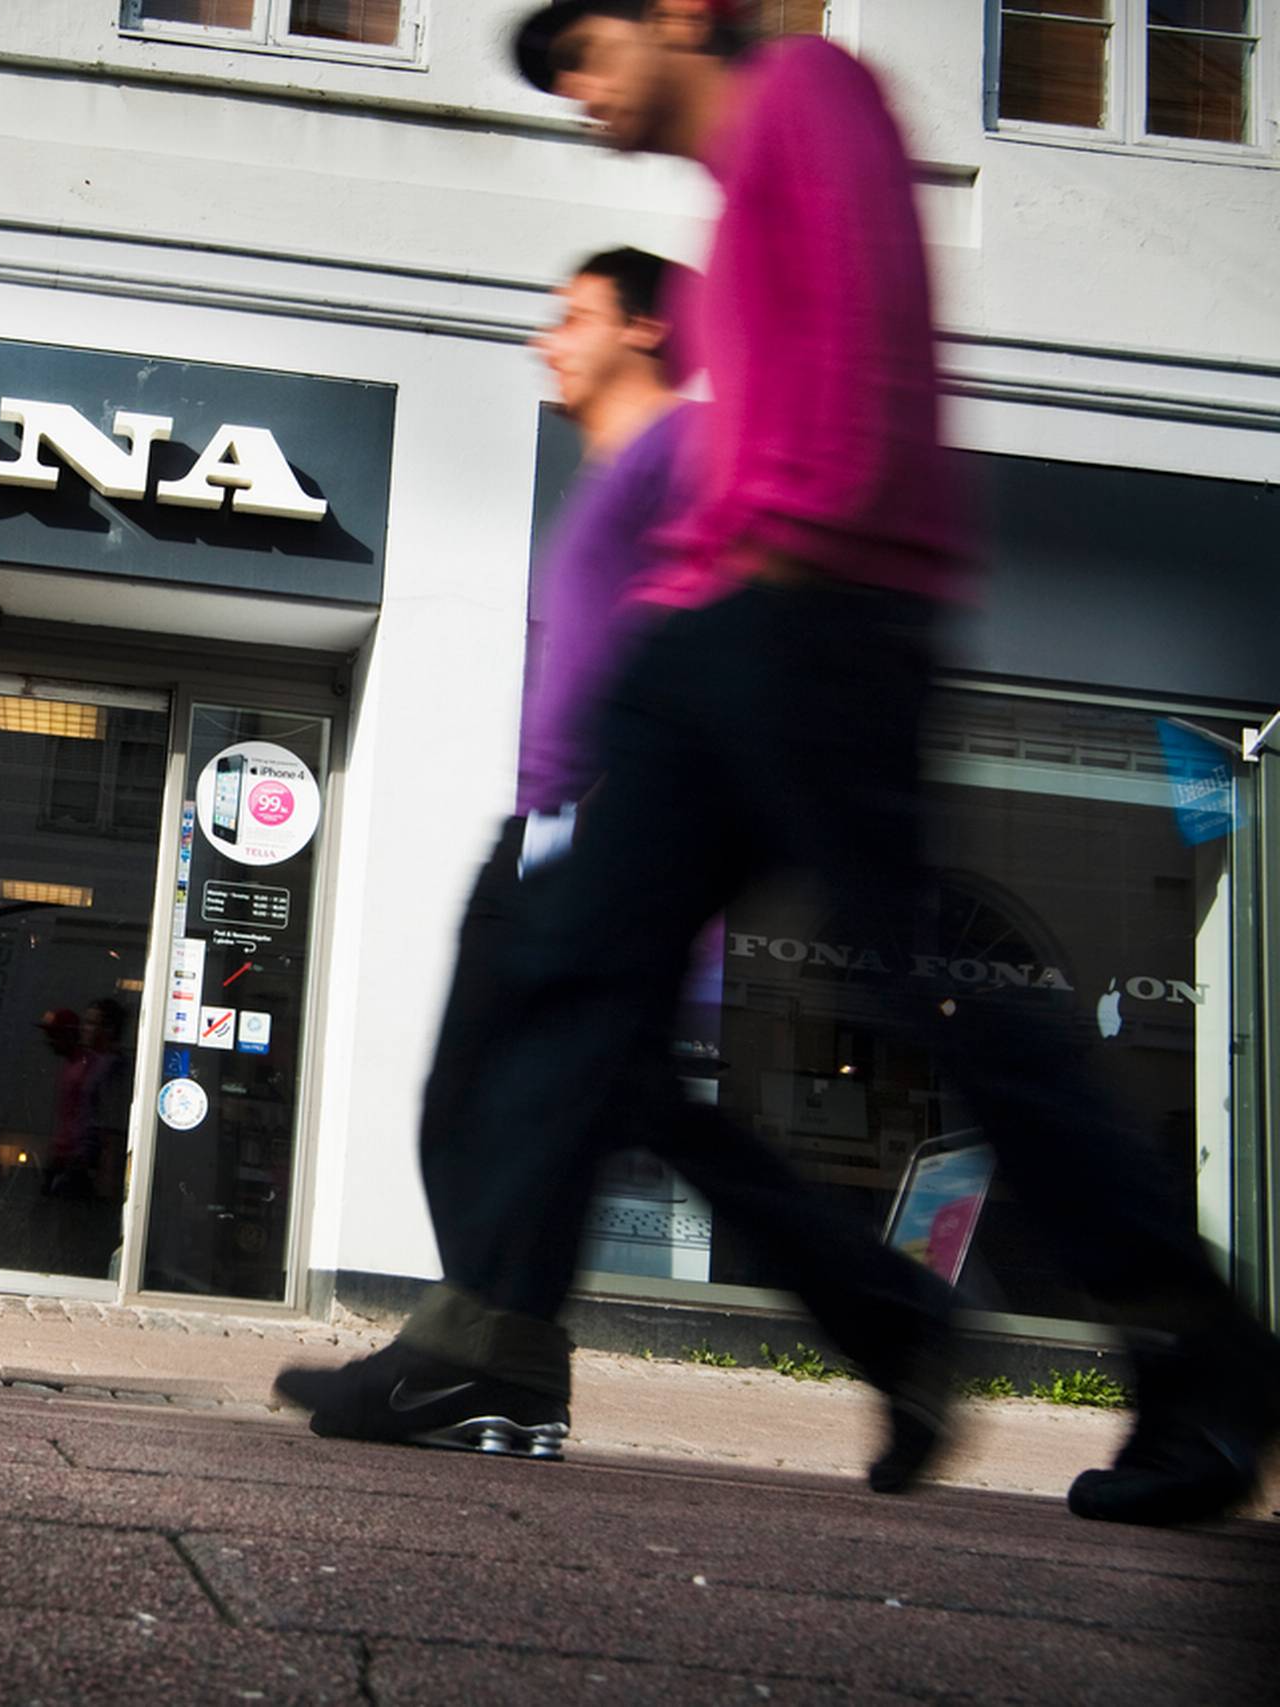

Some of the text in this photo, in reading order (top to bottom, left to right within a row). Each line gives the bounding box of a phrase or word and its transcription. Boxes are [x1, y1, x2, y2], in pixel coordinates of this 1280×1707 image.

[260, 766, 305, 780] iPhone 4
[728, 932, 890, 974] FONA
[908, 953, 1075, 992] FONA
